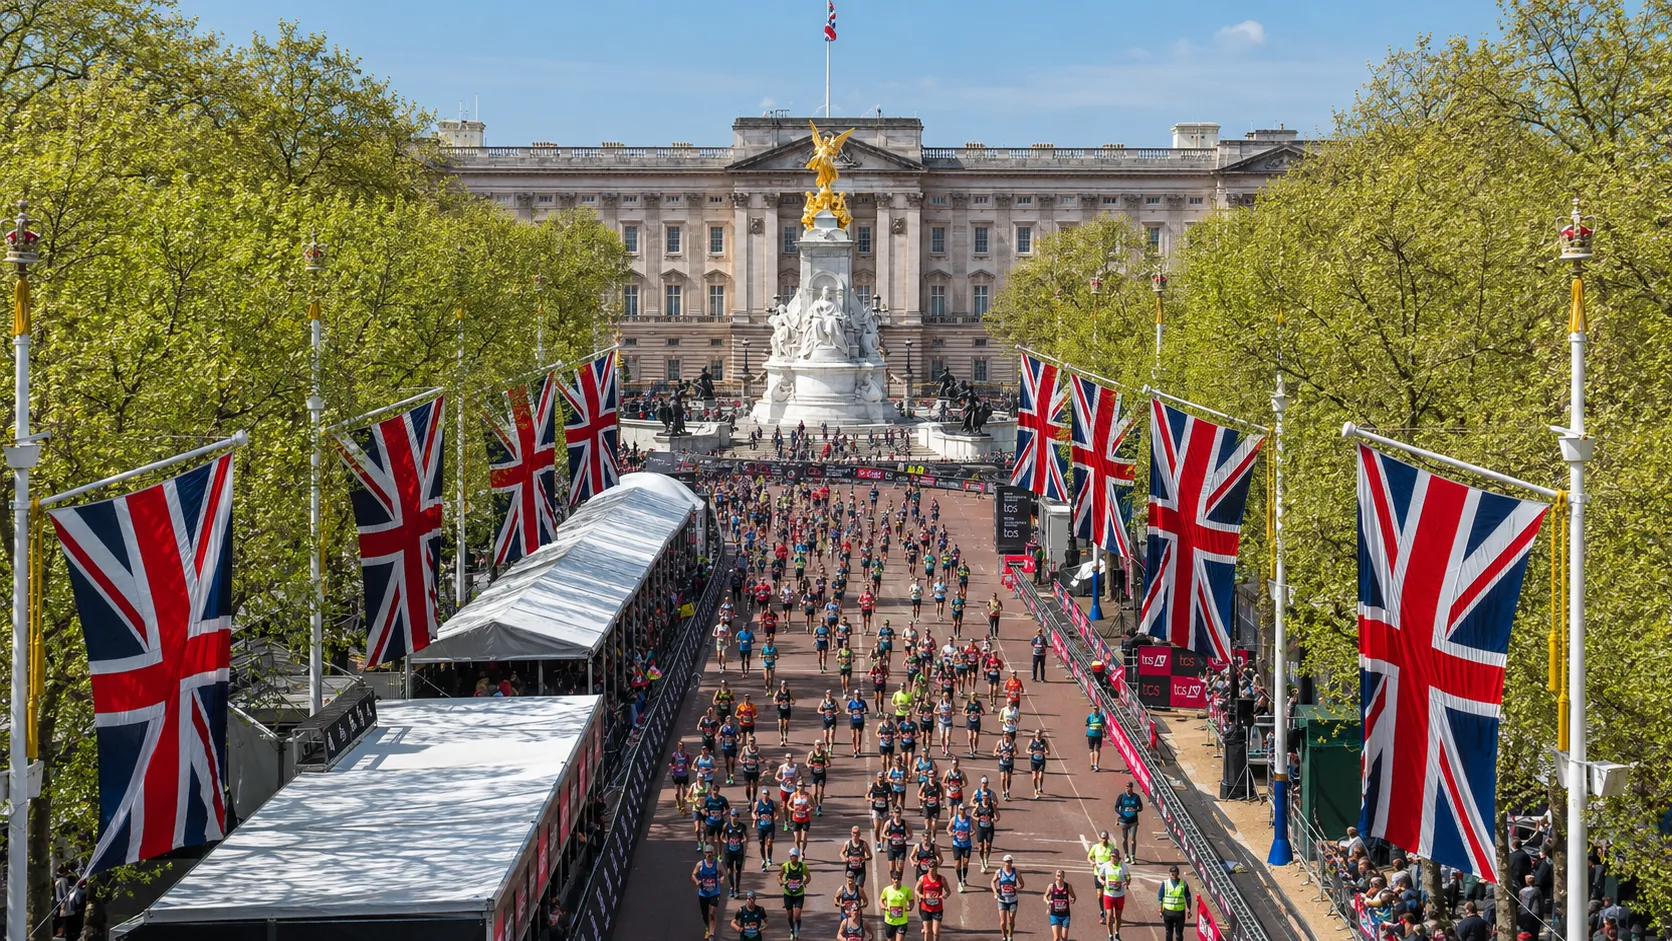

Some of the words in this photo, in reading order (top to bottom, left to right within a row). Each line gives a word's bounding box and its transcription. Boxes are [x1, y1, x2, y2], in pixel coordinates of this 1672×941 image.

[1180, 655, 1195, 667] tcs
[1142, 683, 1160, 698] tcs
[1174, 684, 1187, 696] tcs
